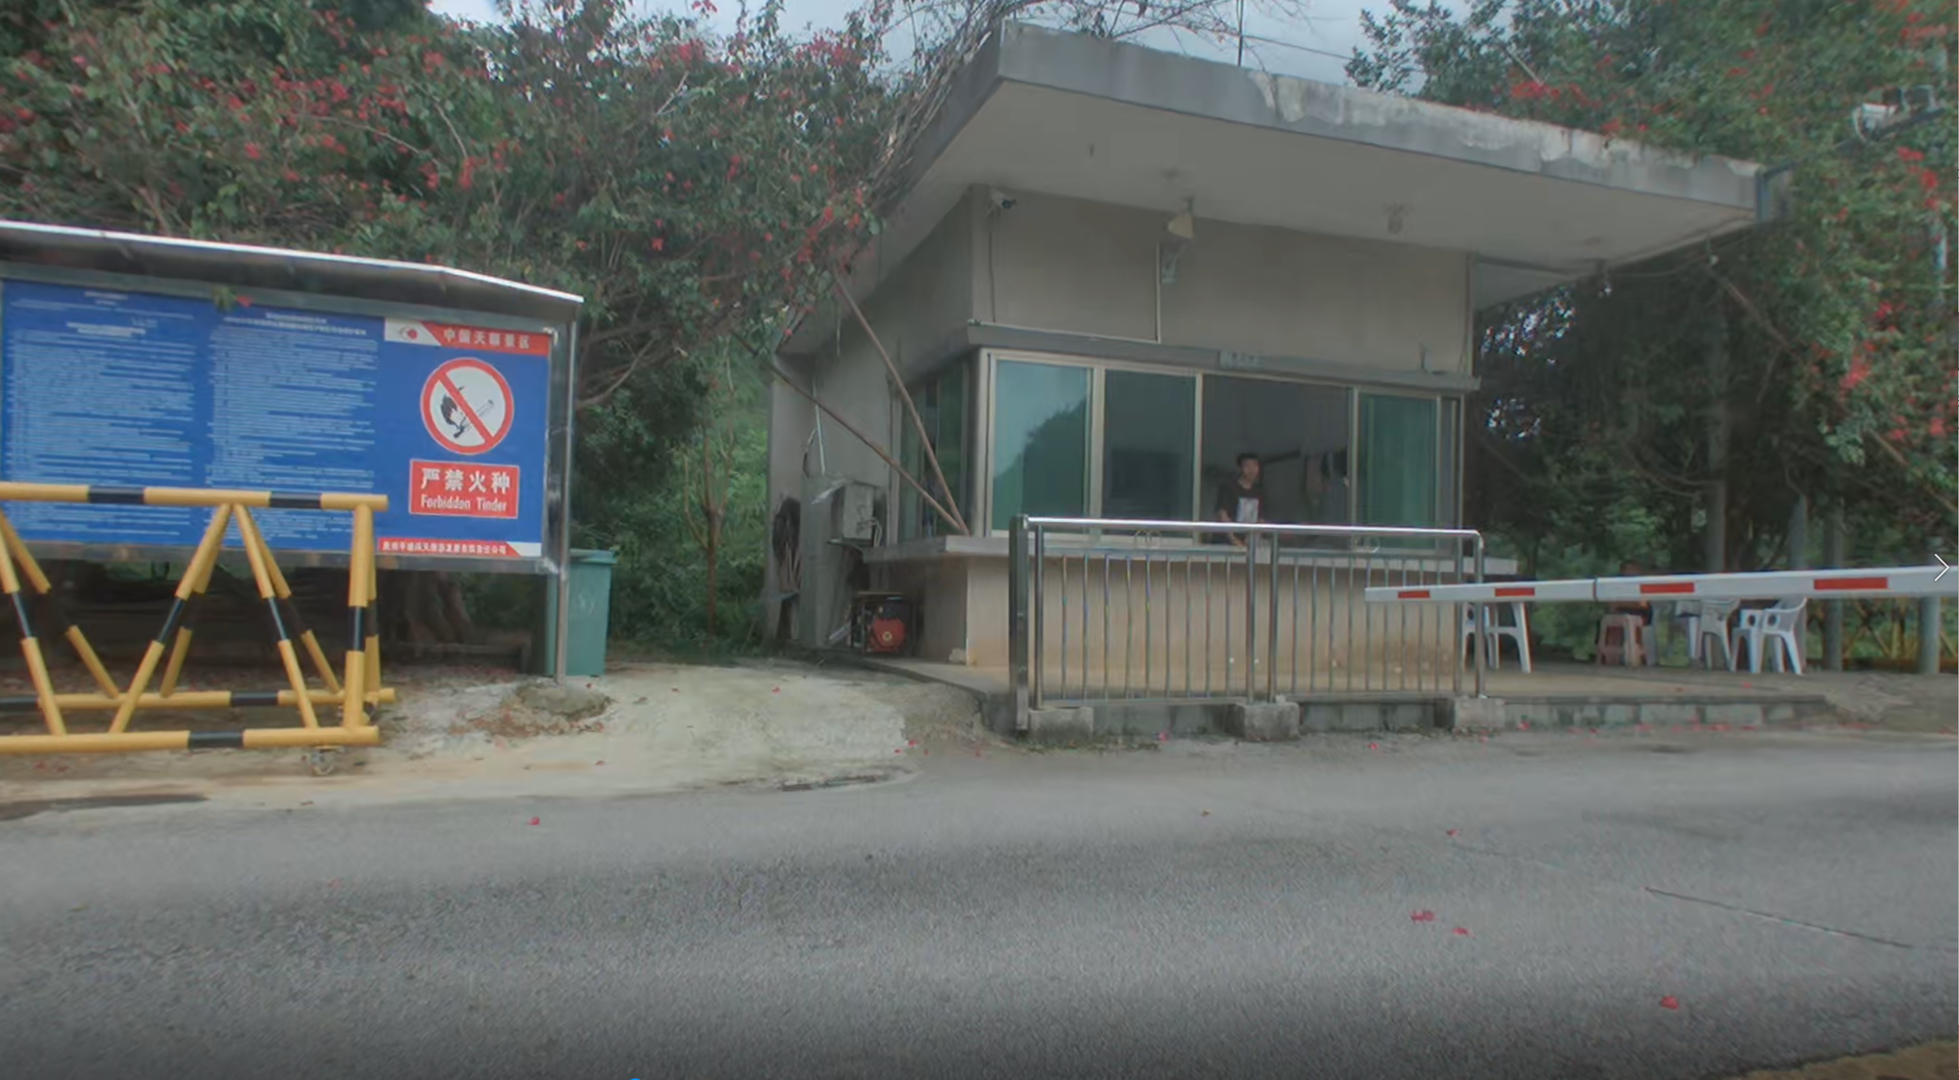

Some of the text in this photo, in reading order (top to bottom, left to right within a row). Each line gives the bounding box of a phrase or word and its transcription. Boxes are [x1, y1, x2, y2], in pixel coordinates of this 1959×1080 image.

[421, 468, 510, 494] 严禁火种
[477, 497, 507, 512] Tinder
